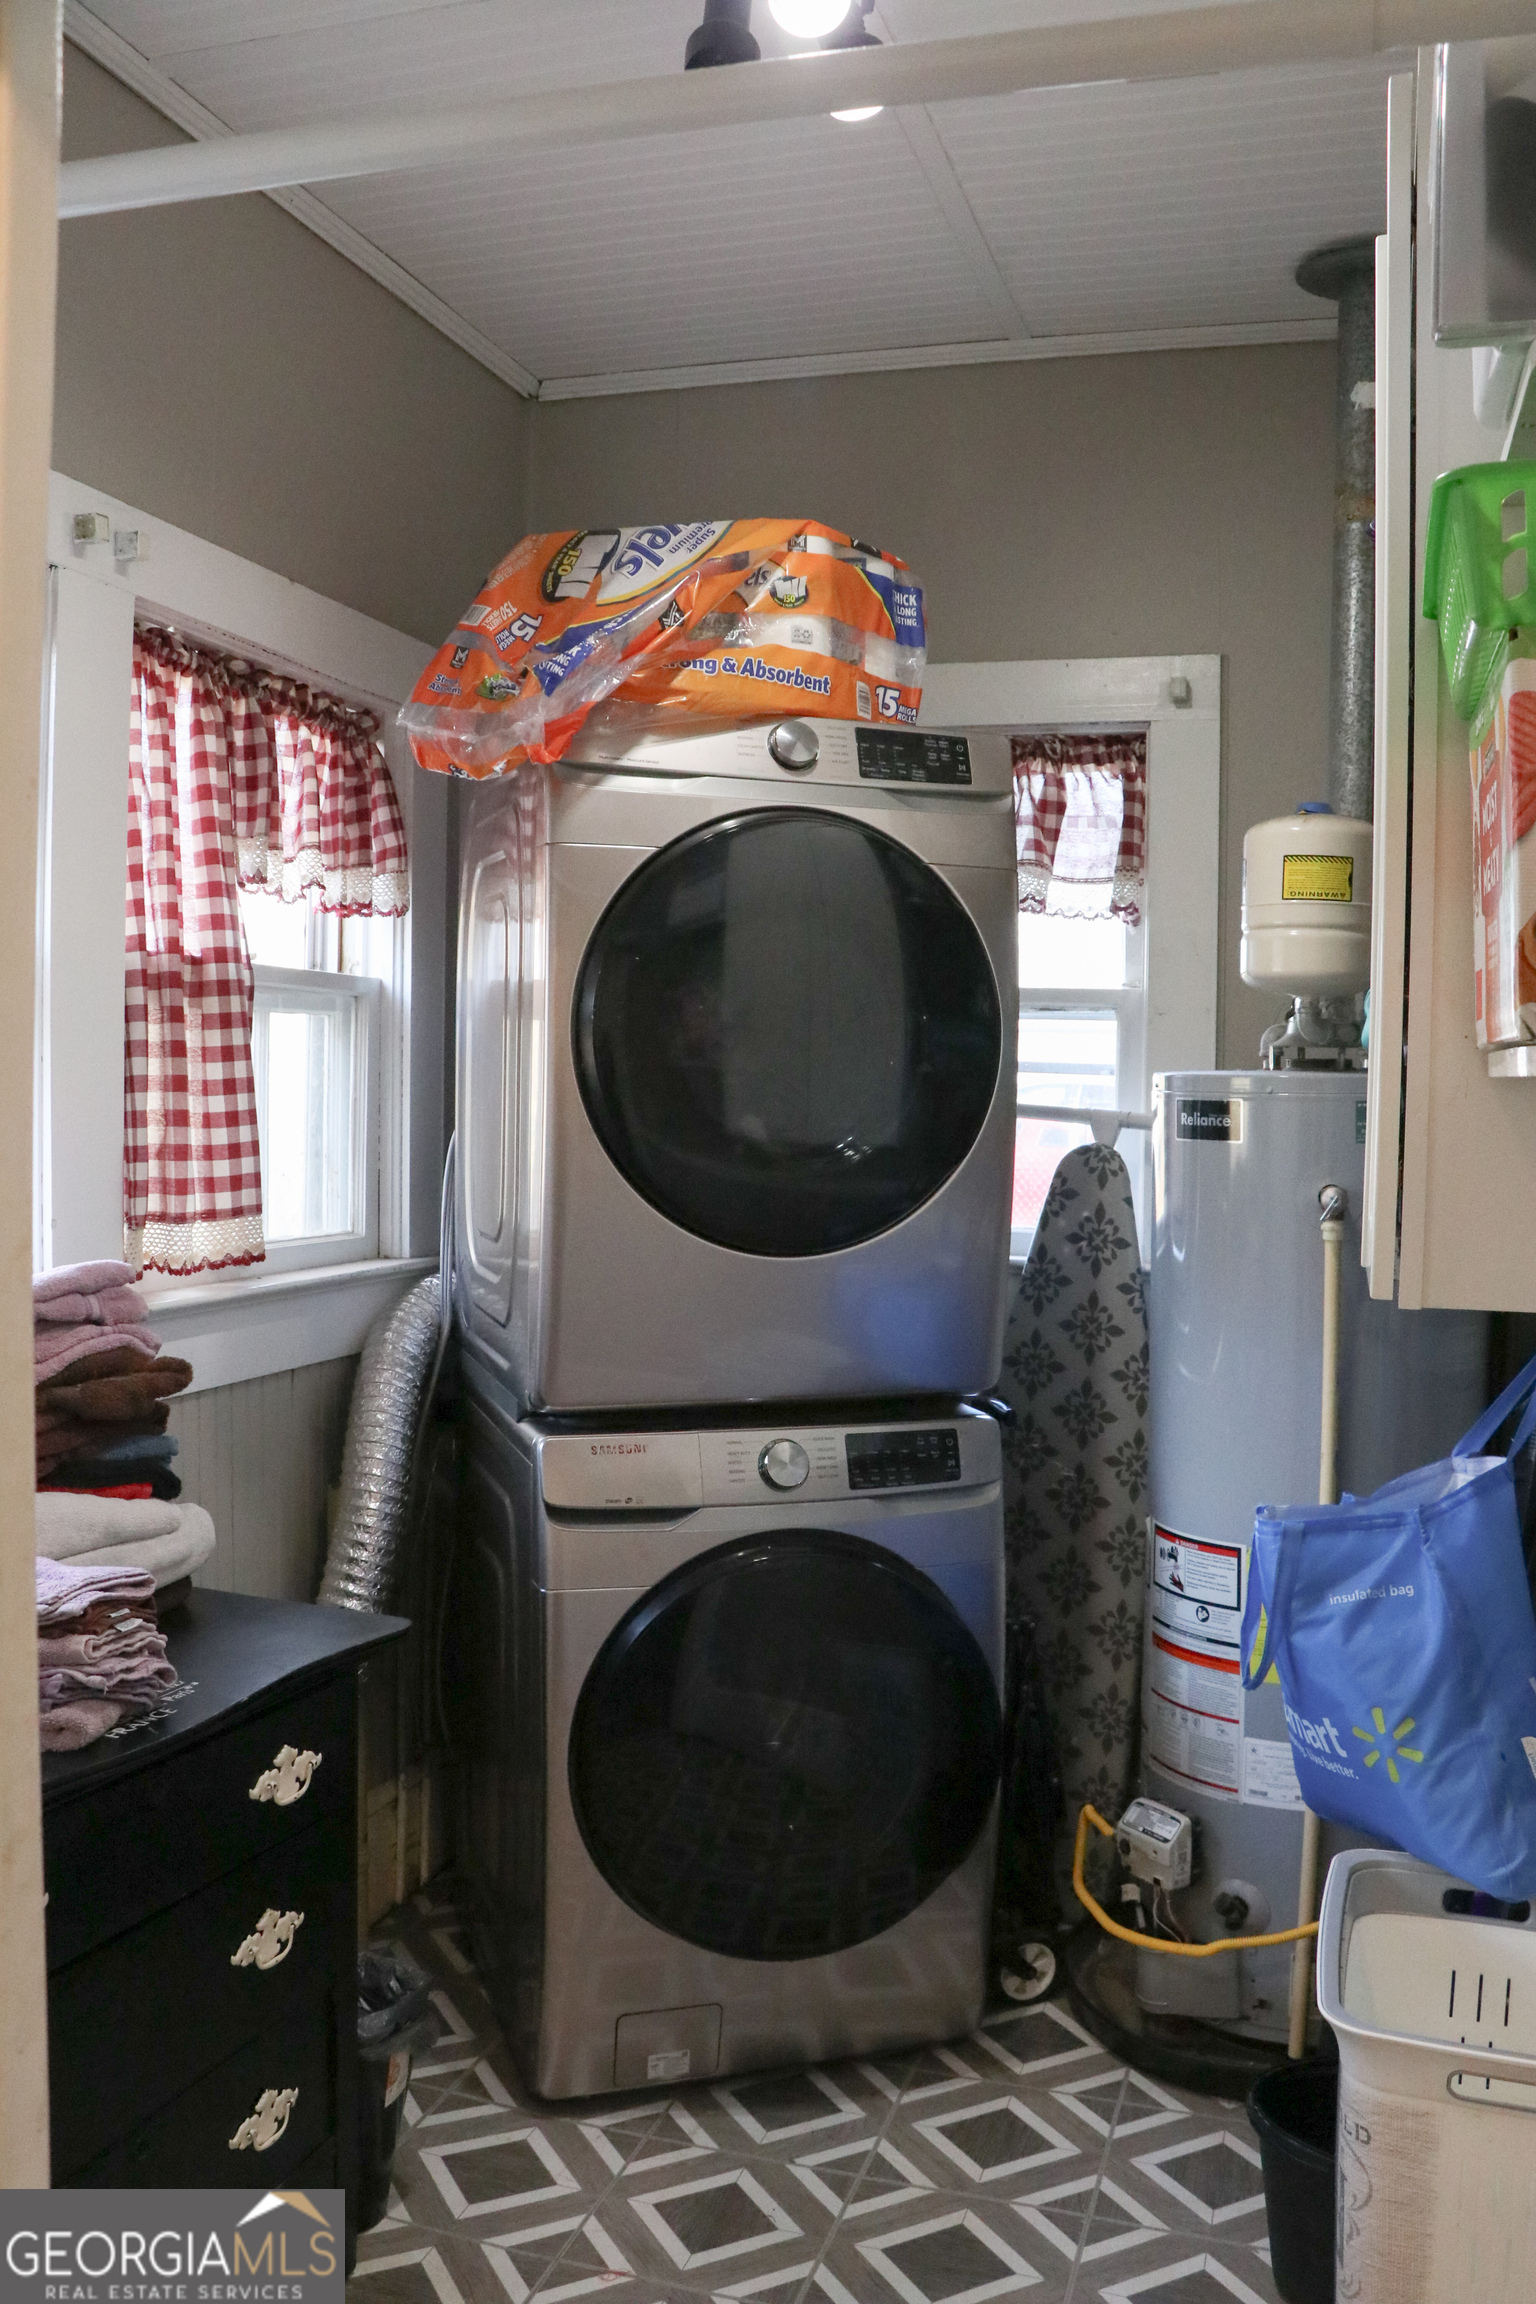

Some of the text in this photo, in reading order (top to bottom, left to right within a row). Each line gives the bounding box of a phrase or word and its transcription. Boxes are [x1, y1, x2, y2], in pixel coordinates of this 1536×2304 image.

[688, 527, 716, 554] Super
[557, 548, 582, 577] 150
[783, 593, 796, 604] 150
[500, 600, 518, 621] 150
[896, 605, 917, 617] LONG
[509, 612, 543, 642] 15
[721, 656, 738, 675] &
[740, 657, 831, 696] Absorbent
[875, 685, 901, 718] 15
[898, 704, 918, 717] MEGA
[897, 713, 917, 724] ROLLS
[1181, 1112, 1231, 1127] Reliance
[1329, 1584, 1415, 1605] insulated bag
[1320, 1755, 1359, 1780] better.
